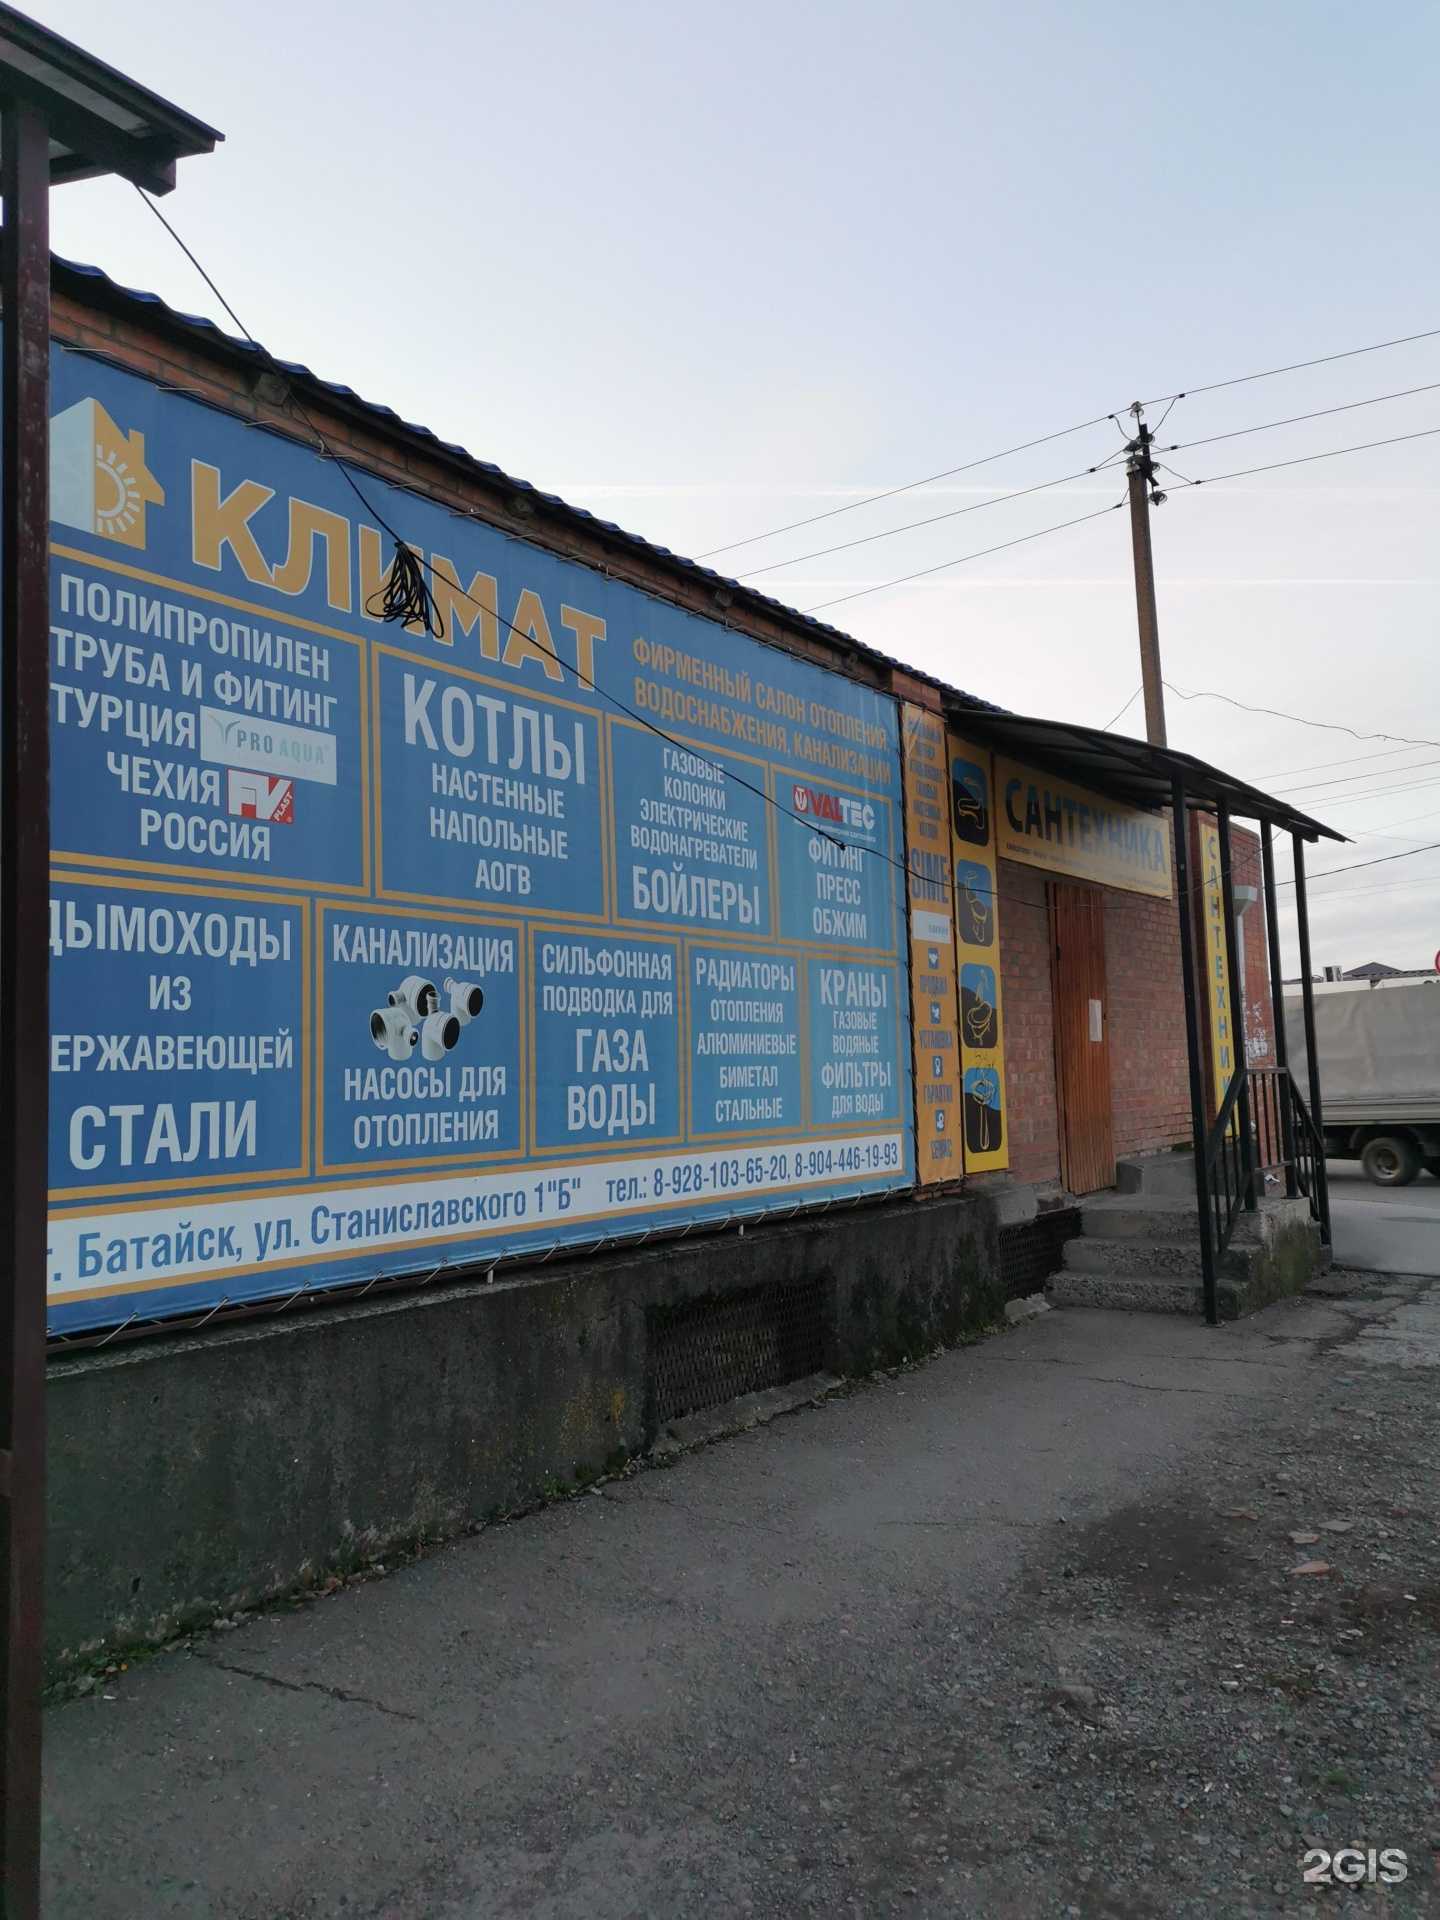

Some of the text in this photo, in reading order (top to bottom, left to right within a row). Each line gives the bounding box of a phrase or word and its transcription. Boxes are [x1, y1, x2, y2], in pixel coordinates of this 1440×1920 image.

[192, 458, 606, 691] КЛИМАТ
[61, 574, 329, 682] ПОЛИПРОПИЛЕН
[50, 626, 337, 728] ТРУБА И ФИТИНГ
[633, 636, 752, 703] ФИРМЕННЫЙ
[755, 683, 805, 725] САЛОН
[810, 702, 887, 751] ОТОПЛЕНИЯ
[50, 682, 195, 749] ТУРЦИЯ
[403, 673, 586, 784] КОТЛЫ
[237, 731, 273, 754] PRO
[794, 730, 891, 785] КАНАЛИЗАЦИИ
[107, 751, 220, 806] ЧЕХИЯ
[663, 747, 725, 785] ГАЗОВЫЕ
[431, 762, 565, 819] НАСТЕННЫЕ
[663, 775, 726, 811] КОЛОНКИ
[807, 788, 875, 830] VALTEC
[141, 808, 270, 862] РОССИЯ
[429, 806, 569, 860] НАПОЛЬНЫЕ
[640, 798, 748, 842] ЭЛЕКТРИЧЕСКИЕ
[631, 825, 758, 871] ВОДОНАГРЕВАТЕЛИ
[808, 836, 865, 873] ФИТИНГ
[475, 859, 531, 895] АОГВ
[632, 862, 760, 925] БОЙЛЕРЫ
[816, 872, 861, 905] ПРЕСС
[813, 907, 867, 939] ОБЖИМ
[333, 924, 514, 977] КАНАЛИЗАЦИЯ
[542, 943, 672, 981] СИЛЬФОННАЯ
[149, 975, 192, 1011] ИЗ
[696, 957, 795, 993] РАДИАТОРЫ
[820, 968, 887, 1009] КРАНЫ
[543, 985, 673, 1019] ПОДВОДКА ДЛЯ
[710, 999, 784, 1024] ОТОПЛЕНИЯ
[832, 1011, 878, 1031] ГАЗОВЫЕ
[576, 1028, 649, 1073] ГАЗА
[697, 1033, 797, 1056] АЛЮМИНИЕВЫЕ
[832, 1034, 879, 1057] ВОДЯНЫЕ
[344, 1066, 506, 1102] НАСОСЫ ДЛЯ
[719, 1065, 778, 1089] БИМЕТАЛ
[821, 1062, 891, 1089] ФИЛЬТРЫ
[567, 1083, 656, 1136] ВОДЫ
[715, 1097, 783, 1123] СТАЛЬНЫЕ
[832, 1094, 884, 1118] ДЛЯ ВОДЫ
[69, 1100, 257, 1170] СТАЛИ
[353, 1109, 499, 1149] ОТОПЛЕНИЯ
[78, 1221, 242, 1279] Батайск,
[254, 1218, 300, 1262] ул.
[310, 1190, 526, 1245] Станиславского
[534, 1177, 581, 1213] 1"Б"
[606, 1169, 647, 1203] тел.:
[654, 1155, 791, 1197] 8-928-103-65-20,
[795, 1142, 898, 1178] 8-904-446-19-93
